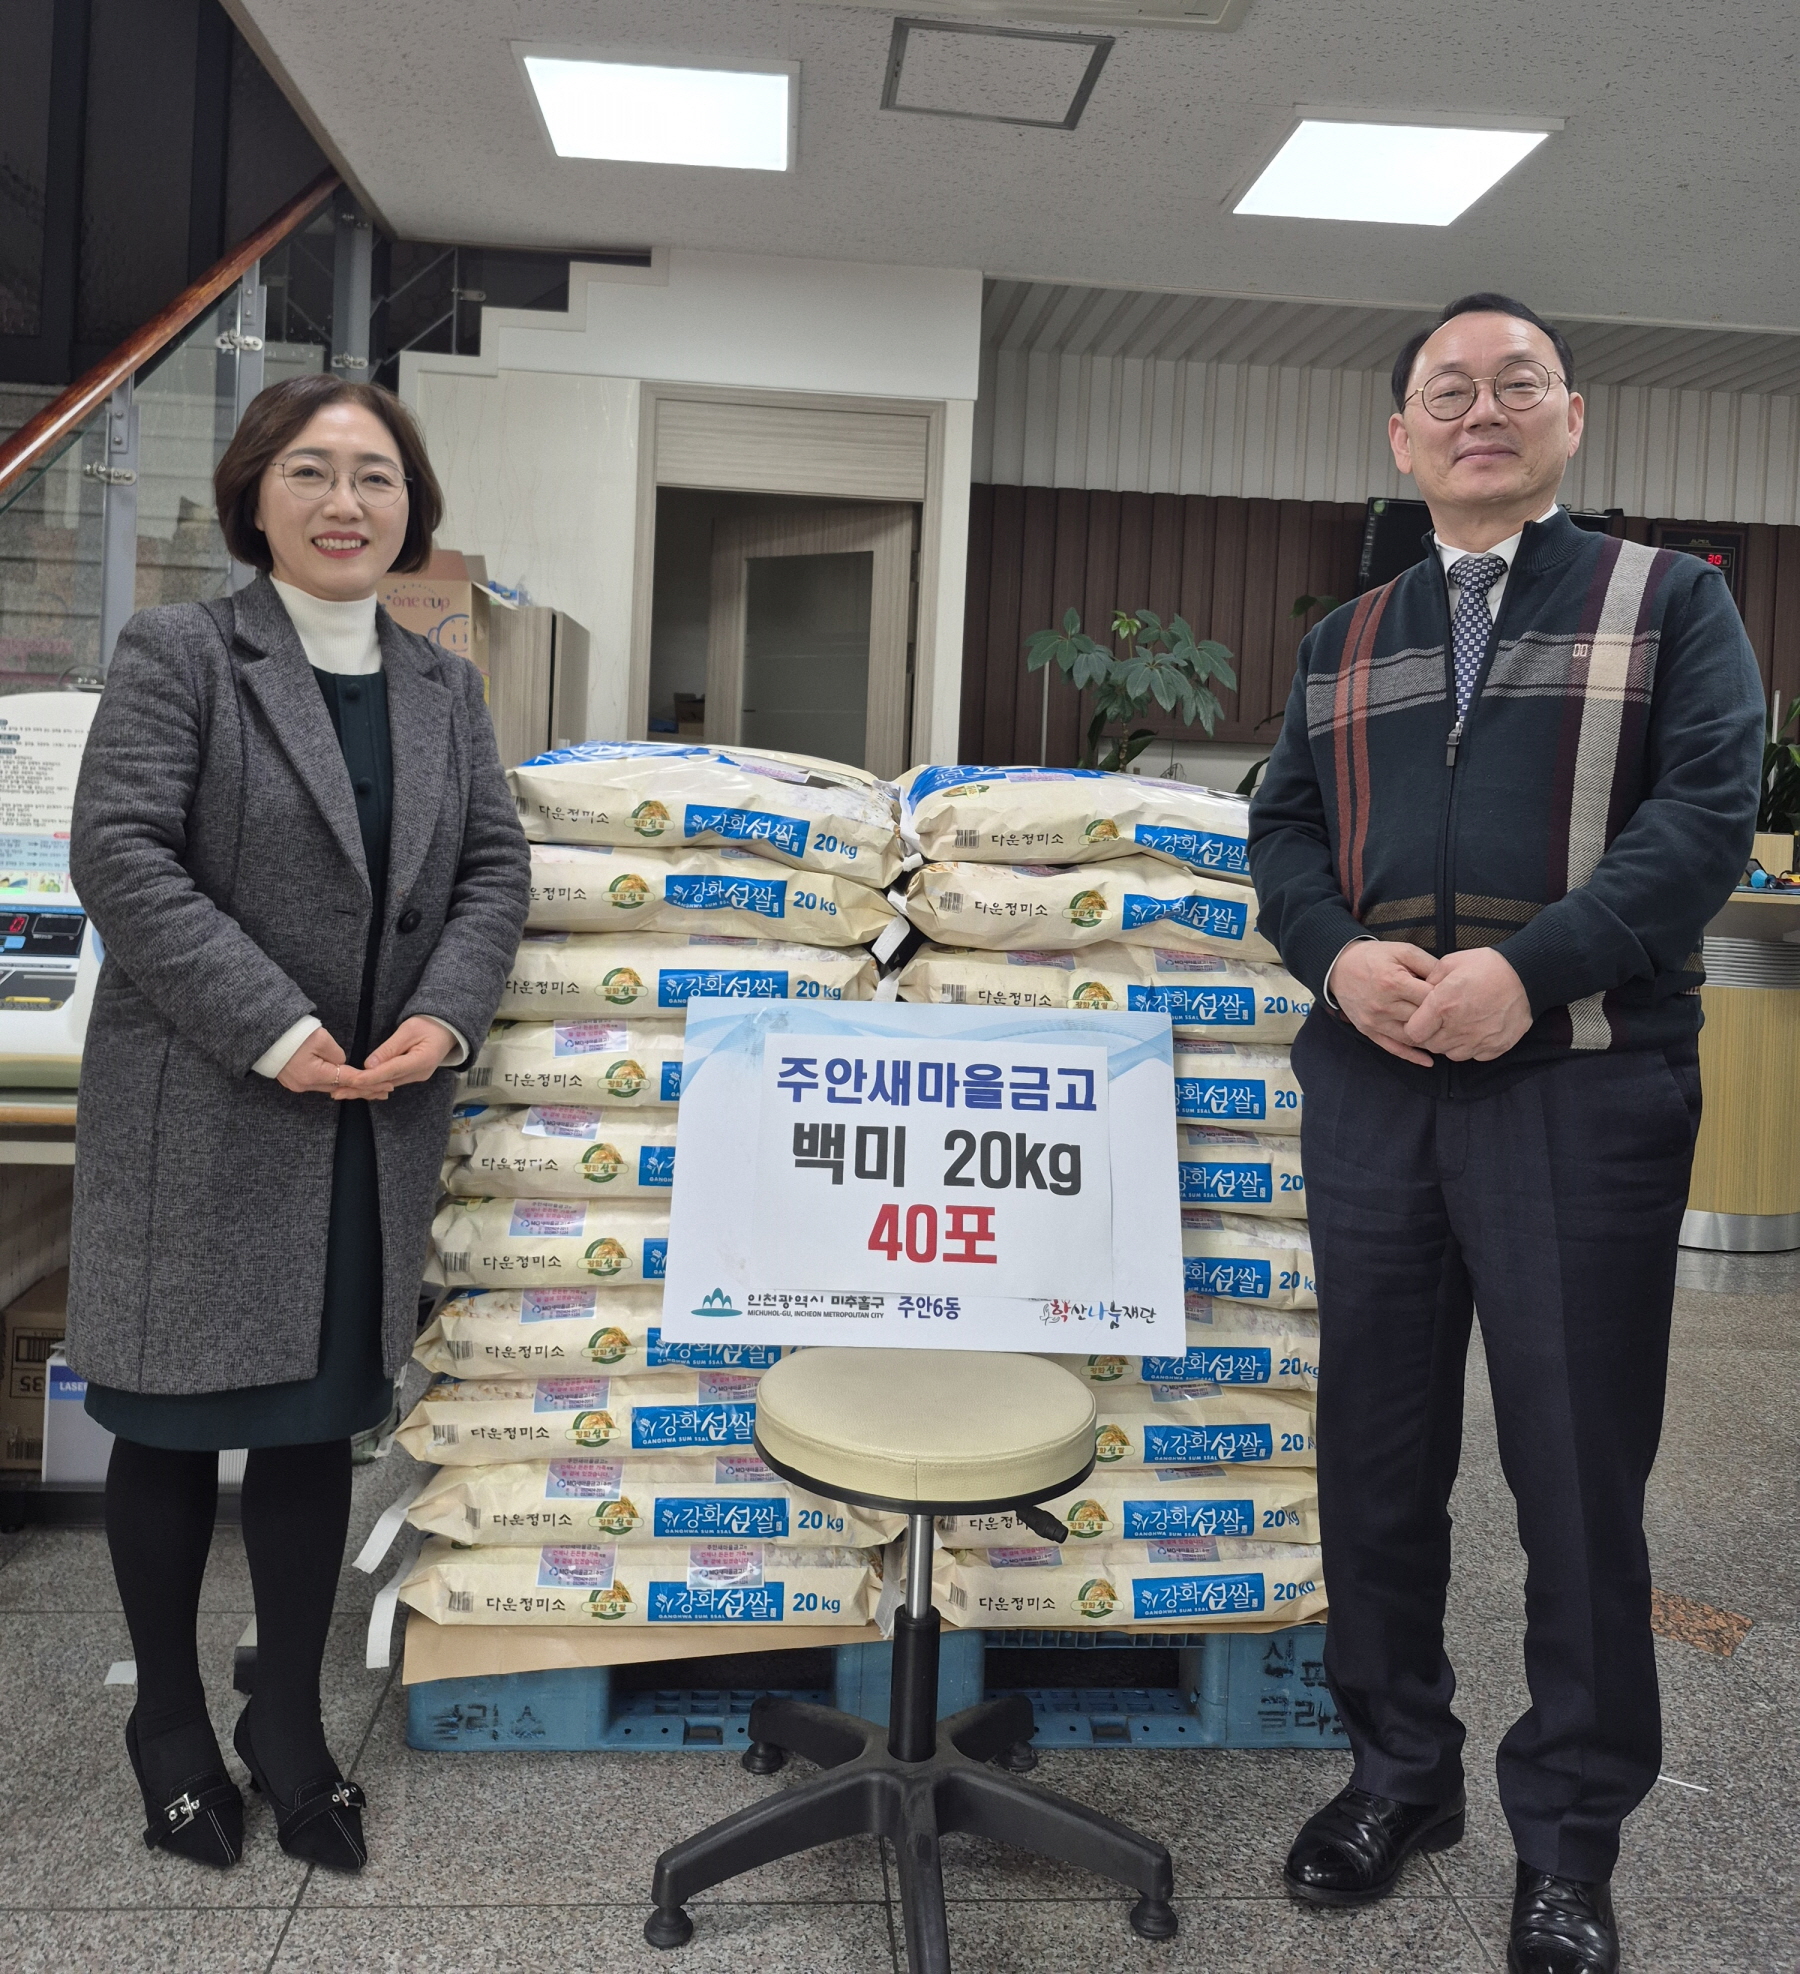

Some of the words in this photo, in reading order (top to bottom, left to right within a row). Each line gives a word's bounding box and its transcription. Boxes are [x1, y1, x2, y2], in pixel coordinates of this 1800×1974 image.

[392, 597, 421, 608] one
[423, 596, 450, 612] cup
[710, 813, 800, 850] 강화섬쌀
[991, 833, 1064, 846] 다운정미소
[813, 833, 838, 853] 20
[840, 841, 858, 860] kg
[1160, 834, 1247, 870] 강화섬쌀
[530, 887, 587, 901] 운정미소
[691, 880, 777, 913] 강화섬쌀
[793, 891, 817, 910] 20
[820, 897, 837, 916] kg
[975, 901, 1048, 916] 다운정미소
[9, 917, 25, 933] 0
[505, 980, 580, 995] 다운정미소
[795, 980, 820, 998] 20
[823, 984, 841, 1000] kg
[979, 990, 1052, 1007] 다운정미소
[1152, 991, 1245, 1020] 강화섬쌀
[1264, 997, 1288, 1014] 20
[1292, 1001, 1311, 1016] kg
[504, 1073, 583, 1088] 다운정미소
[776, 1057, 1098, 1112] 주안새마을금고
[1274, 1090, 1298, 1109] 20
[792, 1123, 907, 1188] 백미
[943, 1129, 1082, 1195] 20kg
[1280, 1173, 1304, 1191] 20
[867, 1203, 998, 1265] 40포
[482, 1255, 562, 1270] 다운정미소
[1279, 1271, 1300, 1290] 20
[1304, 1276, 1317, 1294] k
[747, 1293, 824, 1309] 인천광역시
[830, 1295, 885, 1310] 미추홀구
[897, 1295, 961, 1320] 주안6동
[747, 1310, 793, 1318] MICHUHOL-GU,
[794, 1310, 822, 1318] INCHEON
[823, 1311, 869, 1319] METROPOLITAN
[485, 1345, 565, 1359] 다운정미소
[1168, 1352, 1262, 1381] 강화섬쌀
[1279, 1358, 1301, 1375] 20
[470, 1426, 550, 1439] 다운정미소
[659, 1410, 755, 1440] 강화섬쌀
[1170, 1431, 1263, 1460] 강화섬쌀
[1280, 1433, 1304, 1451] 20
[493, 1513, 572, 1527] 다운정미소
[682, 1503, 780, 1534] 강화섬쌀
[797, 1510, 823, 1530] 20
[827, 1514, 844, 1532] kg
[1151, 1506, 1244, 1536] 강화섬쌀
[1263, 1510, 1286, 1528] 20
[1160, 1581, 1255, 1611] 강화섬쌀
[1273, 1582, 1297, 1601] 20
[486, 1597, 566, 1612] 다운정미소
[676, 1589, 774, 1618] 강화섬쌀
[793, 1593, 818, 1612] 20
[822, 1596, 841, 1614] kg
[979, 1597, 1056, 1612] 다운정미소
